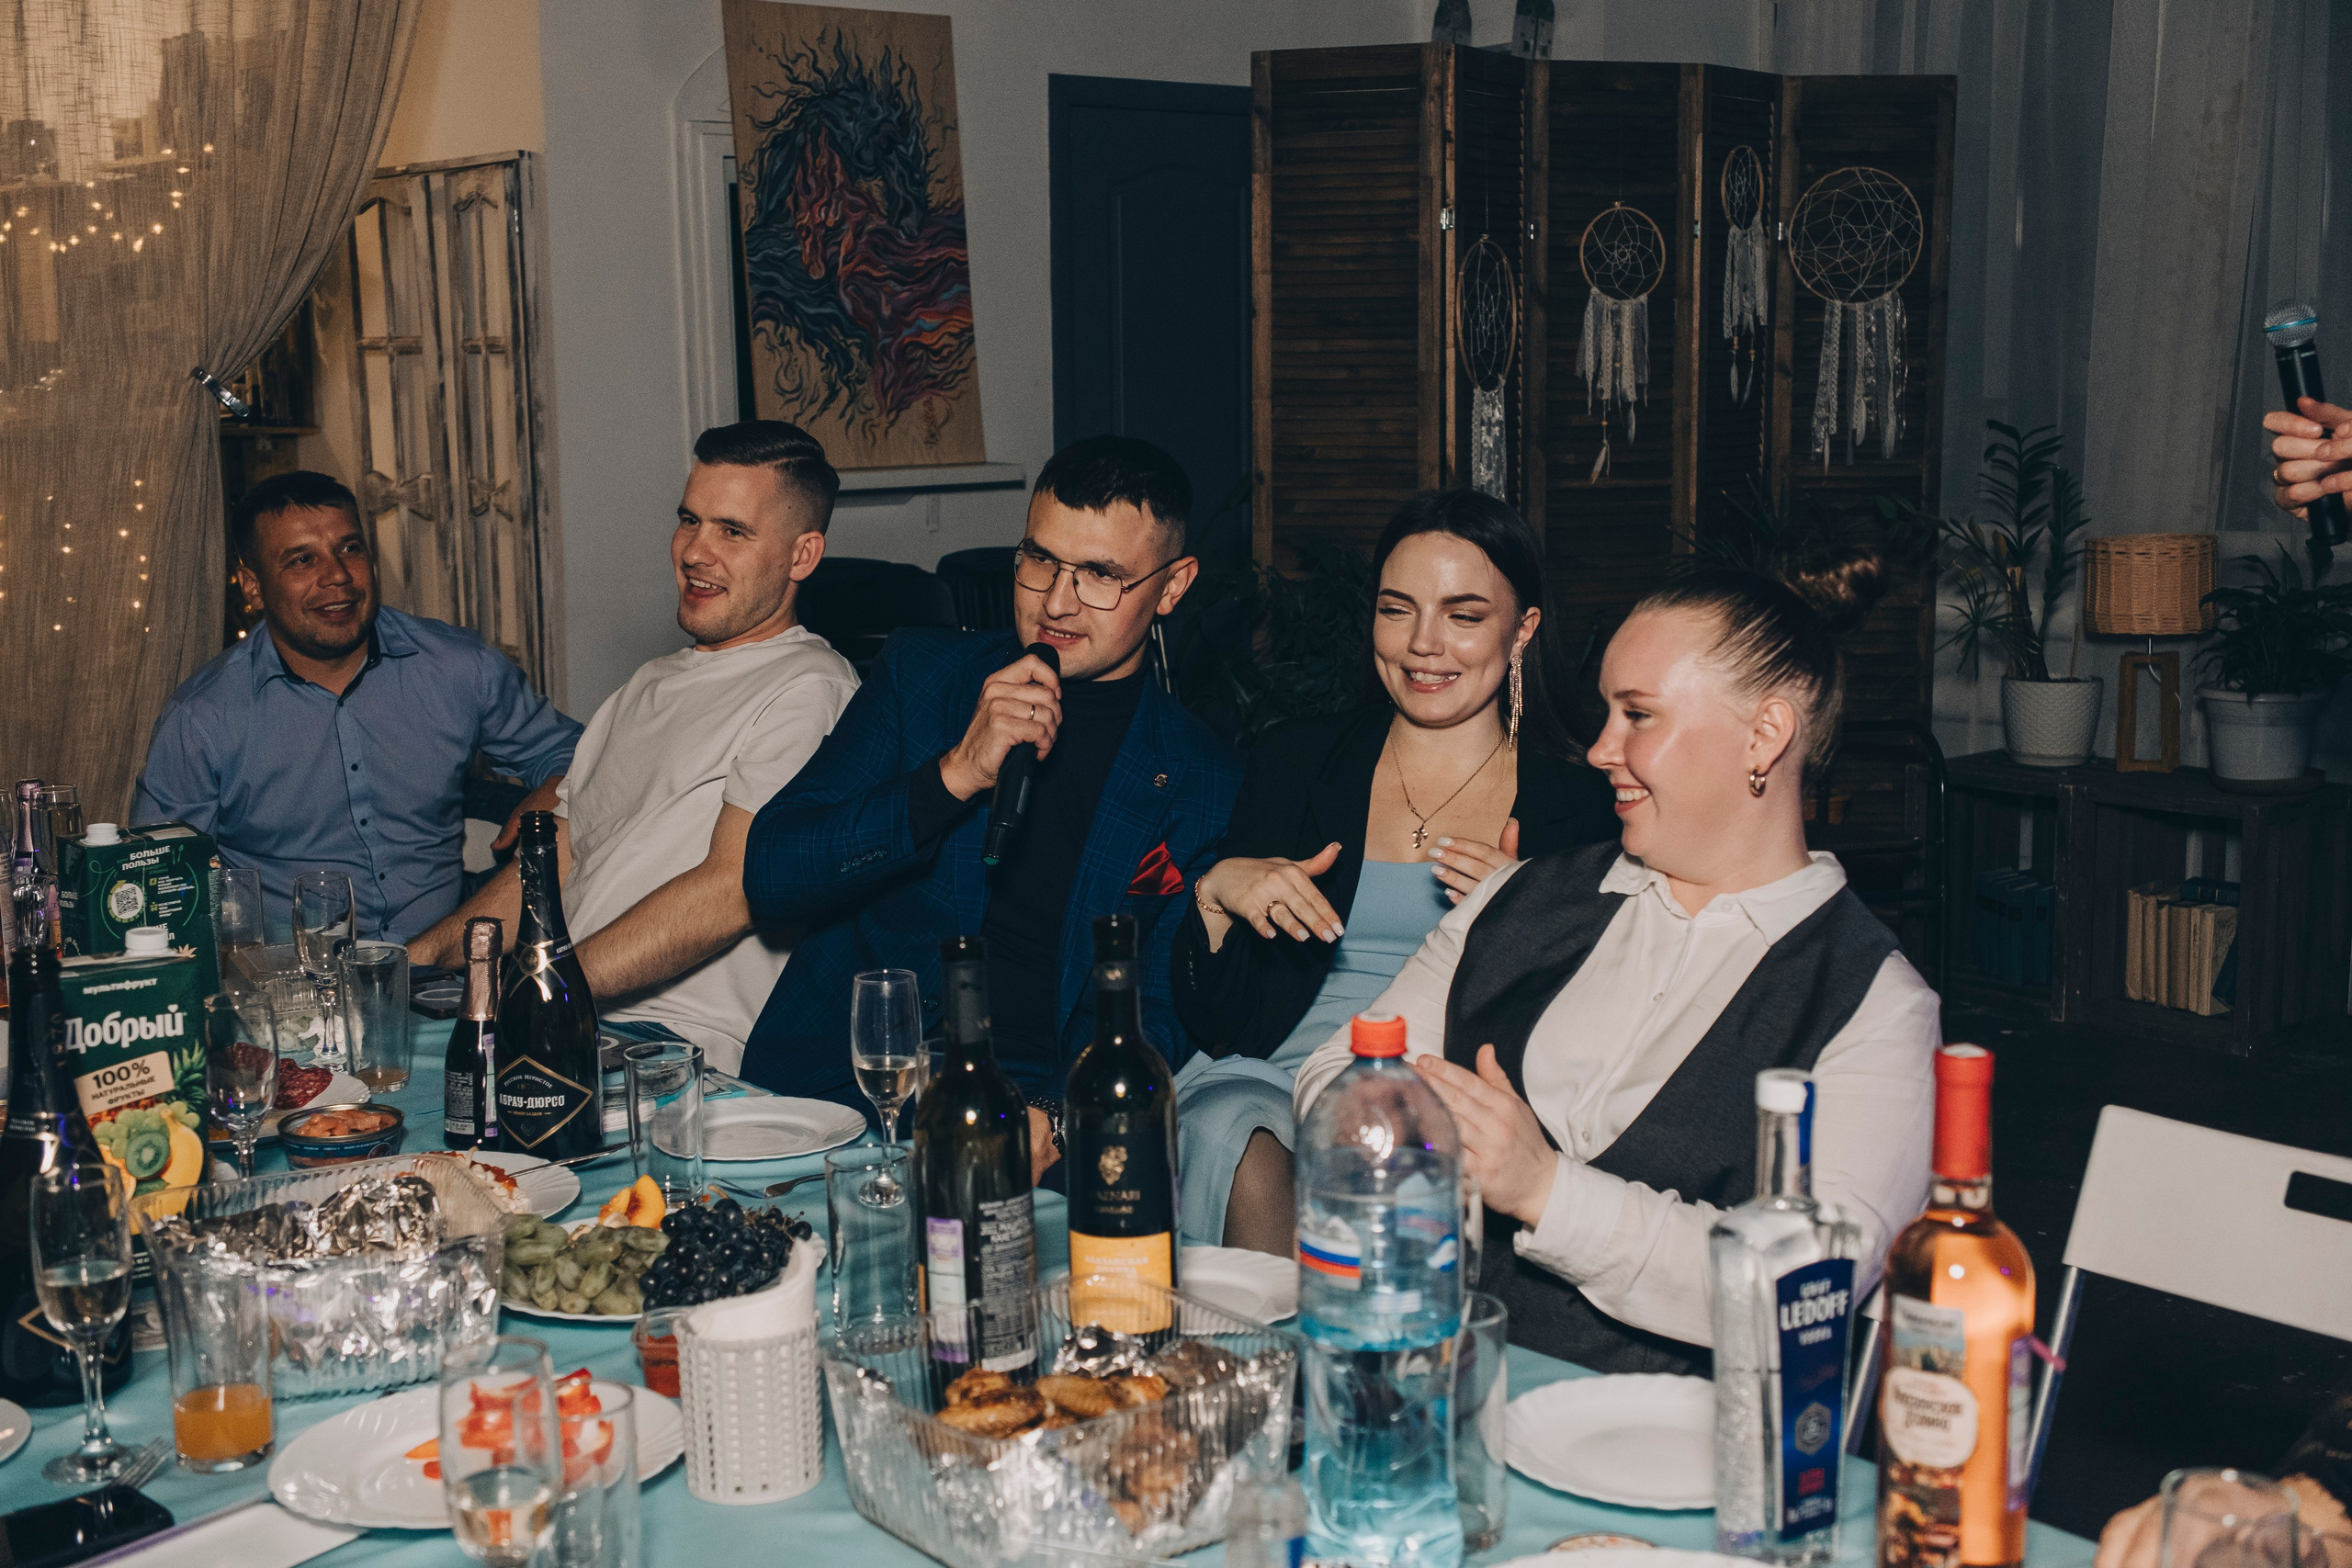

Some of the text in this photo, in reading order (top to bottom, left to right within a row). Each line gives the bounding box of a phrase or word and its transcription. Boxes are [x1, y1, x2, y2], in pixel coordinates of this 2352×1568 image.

[130, 845, 171, 861] БОЛЬШЕ
[122, 856, 159, 871] ПОЛЬЗЫ
[83, 978, 158, 995] мультифрукт
[64, 1004, 185, 1054] Добрый
[93, 1059, 151, 1089] 100%
[503, 1074, 553, 1089] РУССКОЕ ИГРИСТОЕ
[92, 1076, 155, 1100] НАТУРАЛЬНЫЕ
[107, 1089, 145, 1104] ФРУКТЫ
[499, 1093, 565, 1109] АБРАУ-ДЮРСО
[1780, 1288, 1849, 1331] LEDOFF
